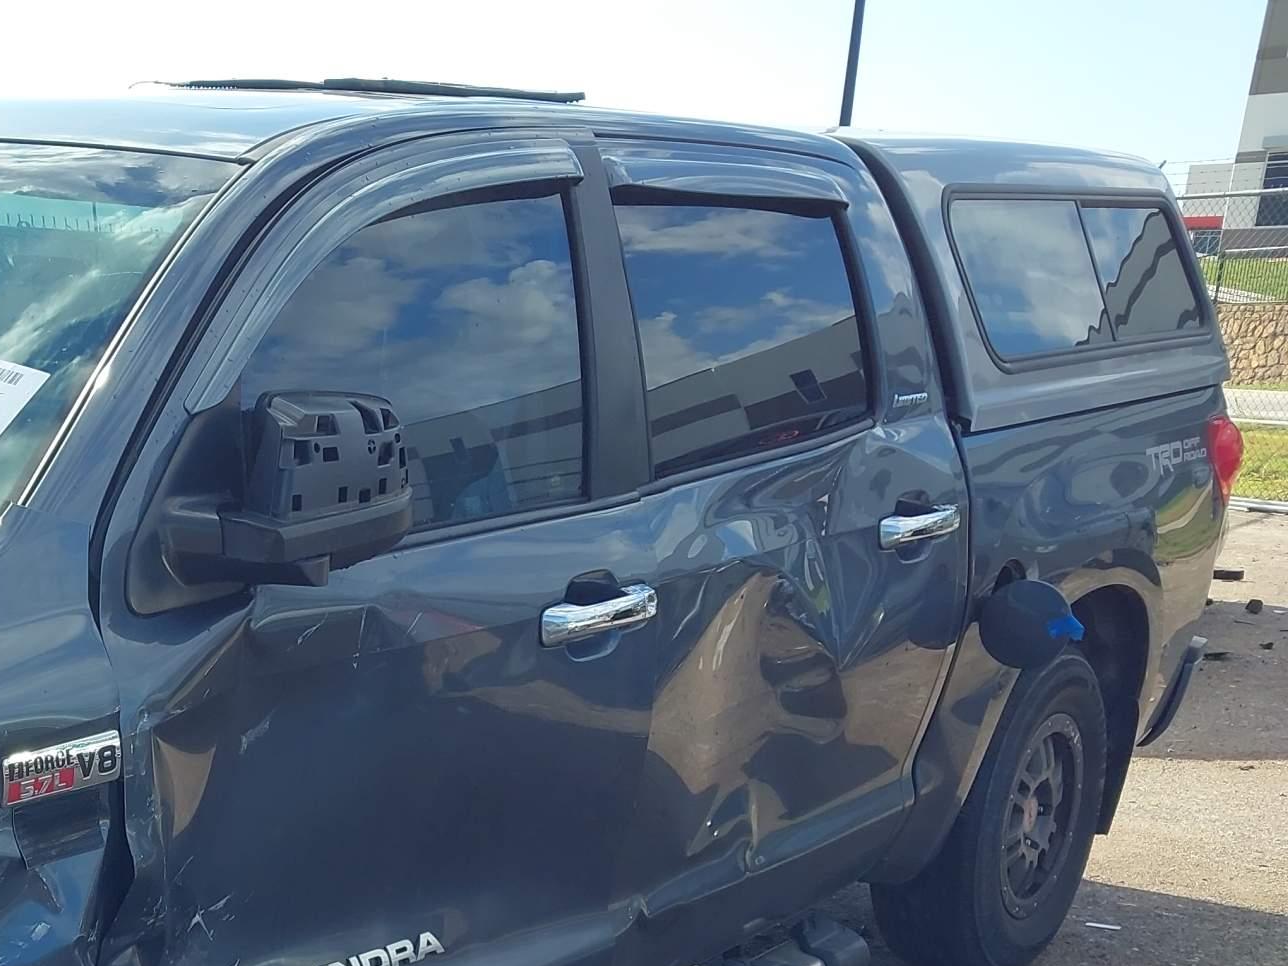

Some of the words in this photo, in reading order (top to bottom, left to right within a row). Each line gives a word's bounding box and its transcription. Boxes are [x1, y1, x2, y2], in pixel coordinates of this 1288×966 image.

[1183, 436, 1200, 449] OFF
[1183, 447, 1207, 462] ROAD
[1145, 440, 1184, 476] TRD
[77, 745, 117, 779] V8
[19, 772, 68, 799] 5.7L
